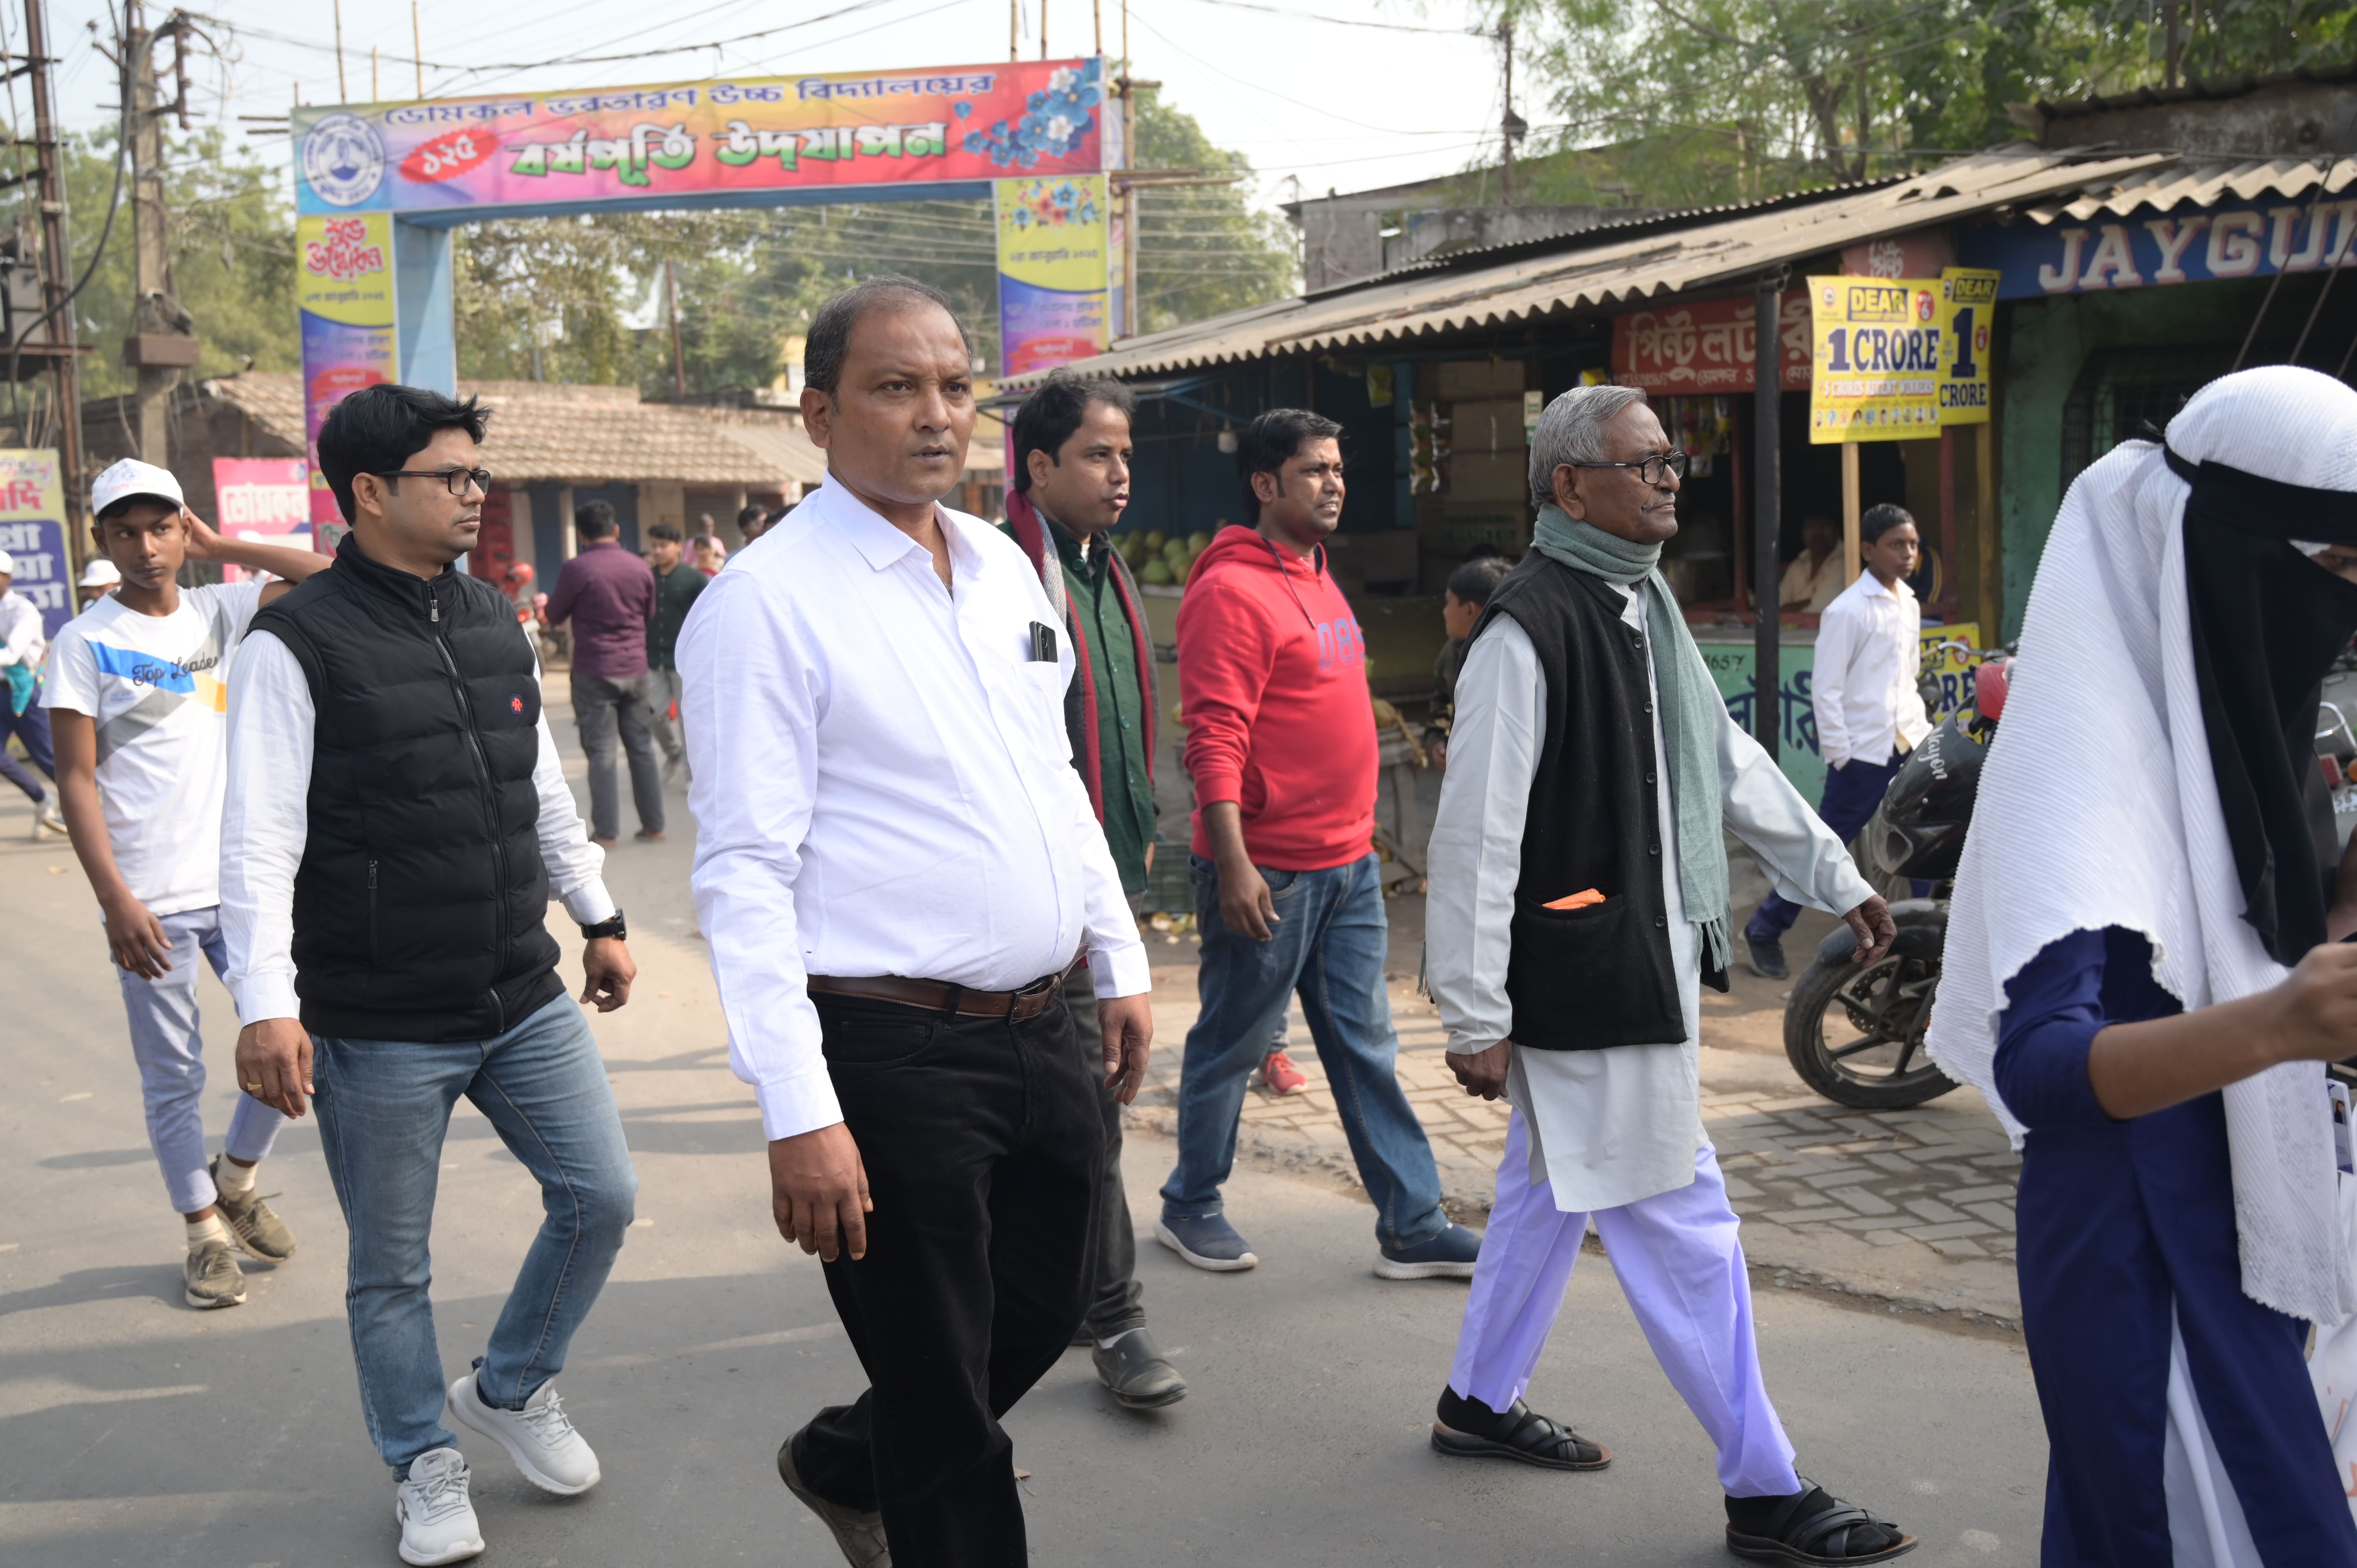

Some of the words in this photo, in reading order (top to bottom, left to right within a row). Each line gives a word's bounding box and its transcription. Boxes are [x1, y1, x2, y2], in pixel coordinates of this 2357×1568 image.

[385, 101, 535, 125] ডোমকল
[546, 88, 699, 116] ভবতারণ
[709, 83, 784, 105] উচ্চ
[795, 73, 996, 102] বিদ্যালয়ের
[423, 134, 478, 175] ১২৫
[505, 122, 697, 187] বর্ষপূর্তি
[1850, 288, 1906, 313] DEAR
[1954, 279, 1993, 295] DEAR
[1625, 311, 1697, 381] পিন্টু
[1828, 328, 1851, 371] 1
[1853, 328, 1940, 372] CRORE
[1951, 307, 1976, 378] 1
[1940, 383, 1987, 408] CRORE
[132, 662, 165, 688] Top
[1917, 726, 1948, 780] Nayon
